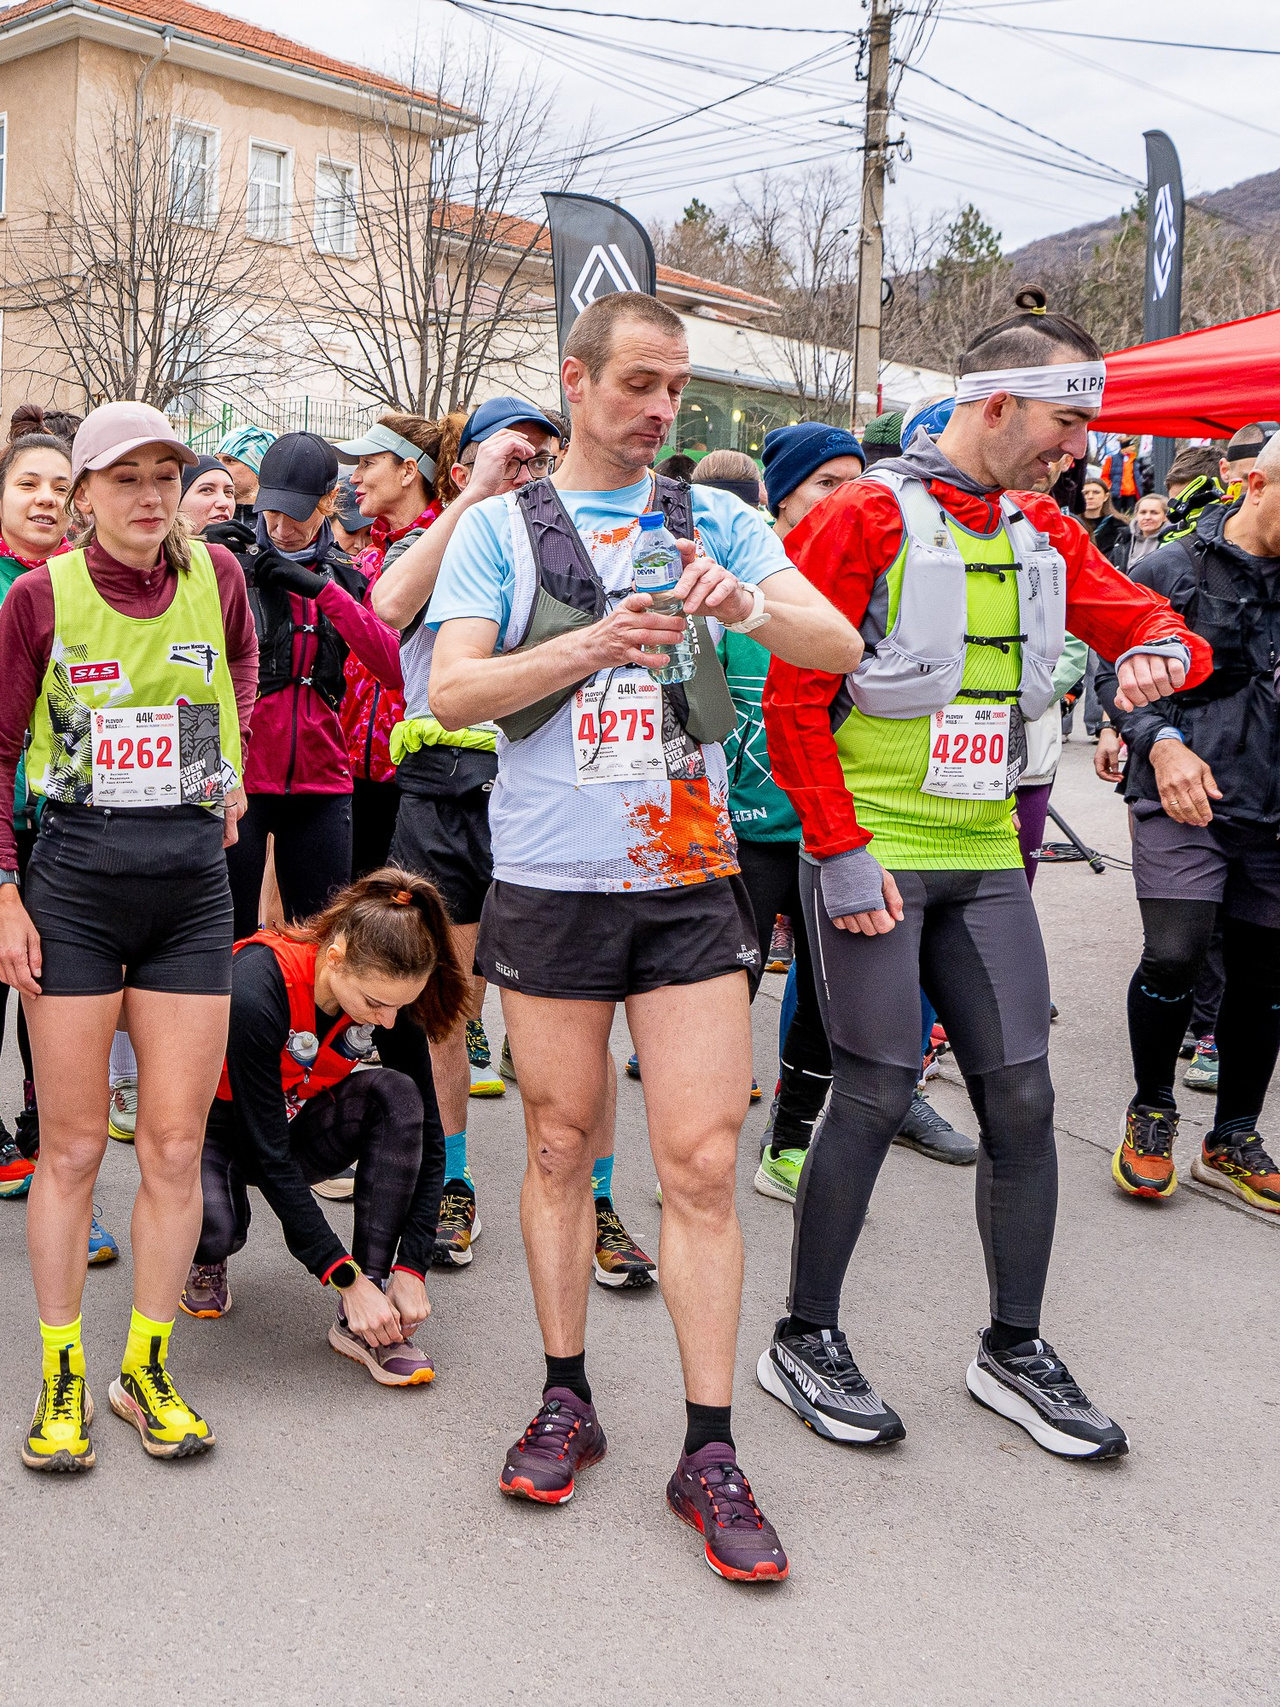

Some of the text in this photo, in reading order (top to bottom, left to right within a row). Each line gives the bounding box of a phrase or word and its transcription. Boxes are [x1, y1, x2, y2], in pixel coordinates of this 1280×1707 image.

[636, 568, 656, 576] DEVIN
[1052, 563, 1060, 596] KIPRUN
[73, 665, 117, 678] SLS
[617, 683, 637, 695] 44K
[135, 712, 174, 723] 44K 20000+
[974, 710, 991, 720] 44K
[577, 709, 655, 745] 4275
[96, 736, 173, 770] 4262
[664, 747, 683, 761] STEP
[932, 733, 1004, 764] 4280
[181, 771, 203, 788] STEP
[775, 1342, 821, 1404] KIPRUN
